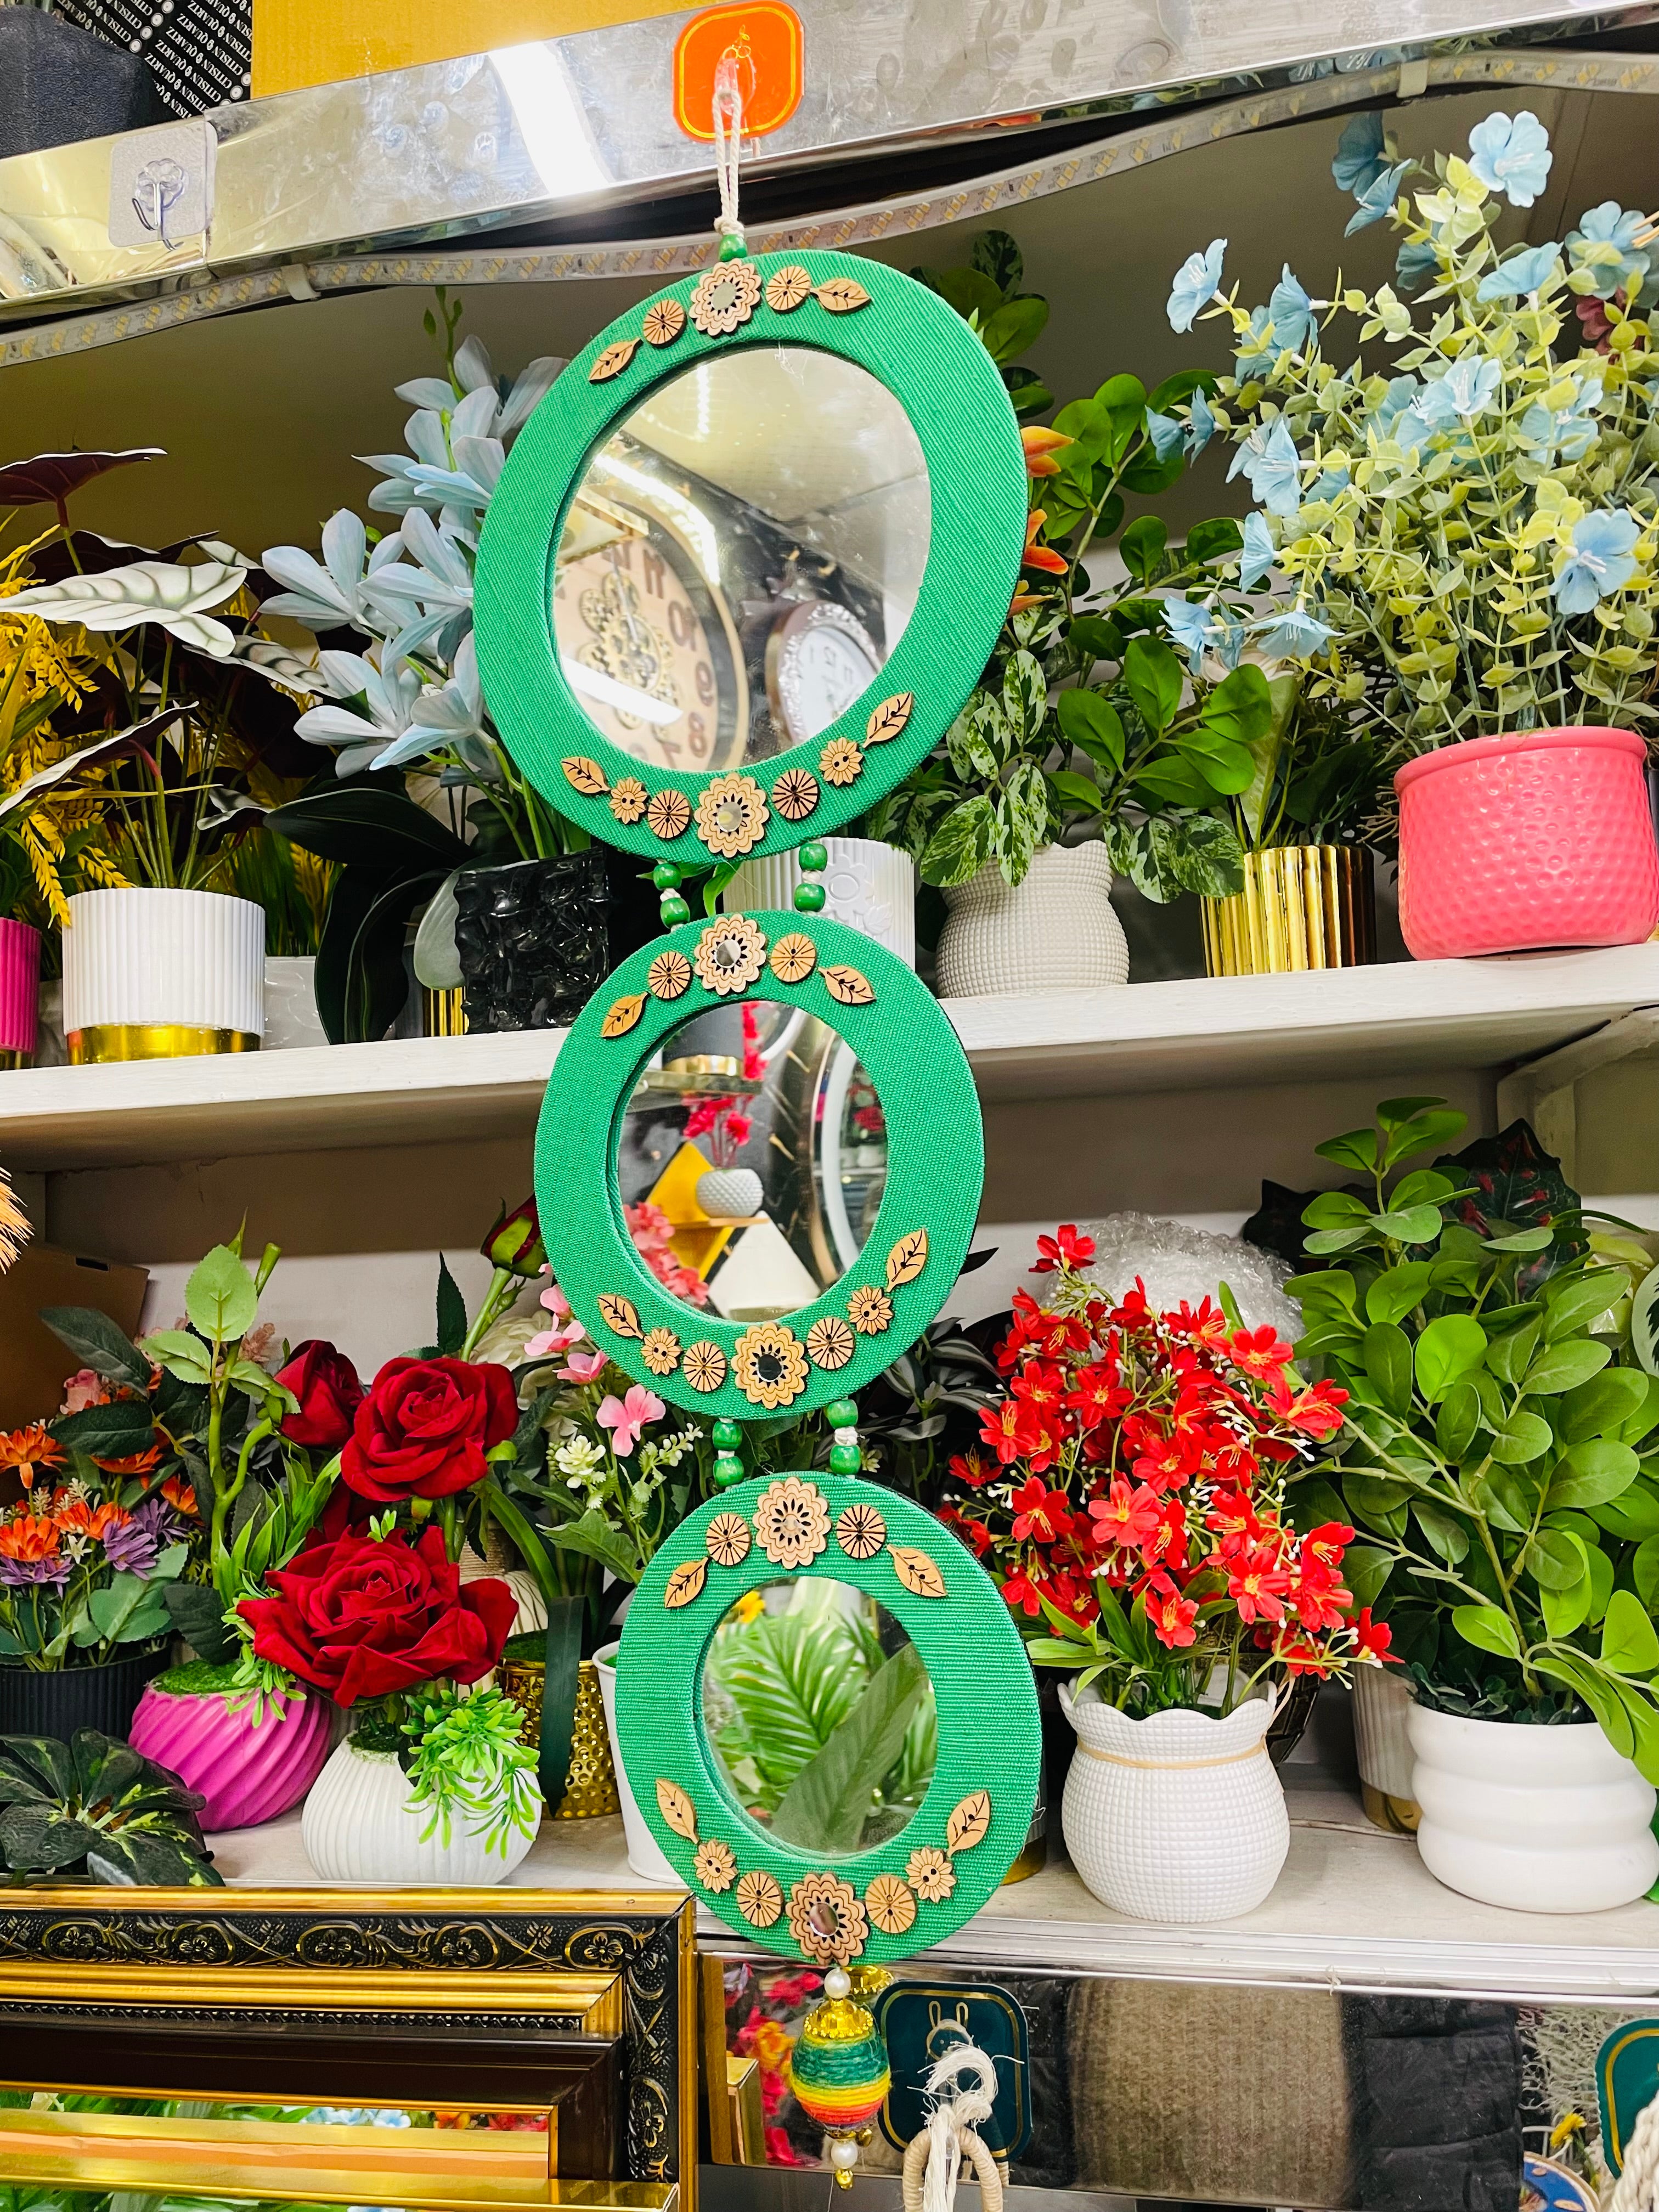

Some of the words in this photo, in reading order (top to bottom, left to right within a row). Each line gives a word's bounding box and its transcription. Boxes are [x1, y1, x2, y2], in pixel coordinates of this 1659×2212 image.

[57, 0, 87, 22] QUART
[111, 0, 142, 29] CITISUN
[188, 1, 219, 30] QUARTZ
[101, 13, 131, 42] CITISUN
[166, 26, 198, 57] QUARTZ
[177, 13, 208, 43] QUARTZ
[144, 53, 176, 83] QUARTZ
[155, 40, 187, 70] QUARTZ
[212, 46, 243, 76] CITISUN
[190, 72, 221, 102] CITISUN
[201, 59, 232, 89] CITISUN
